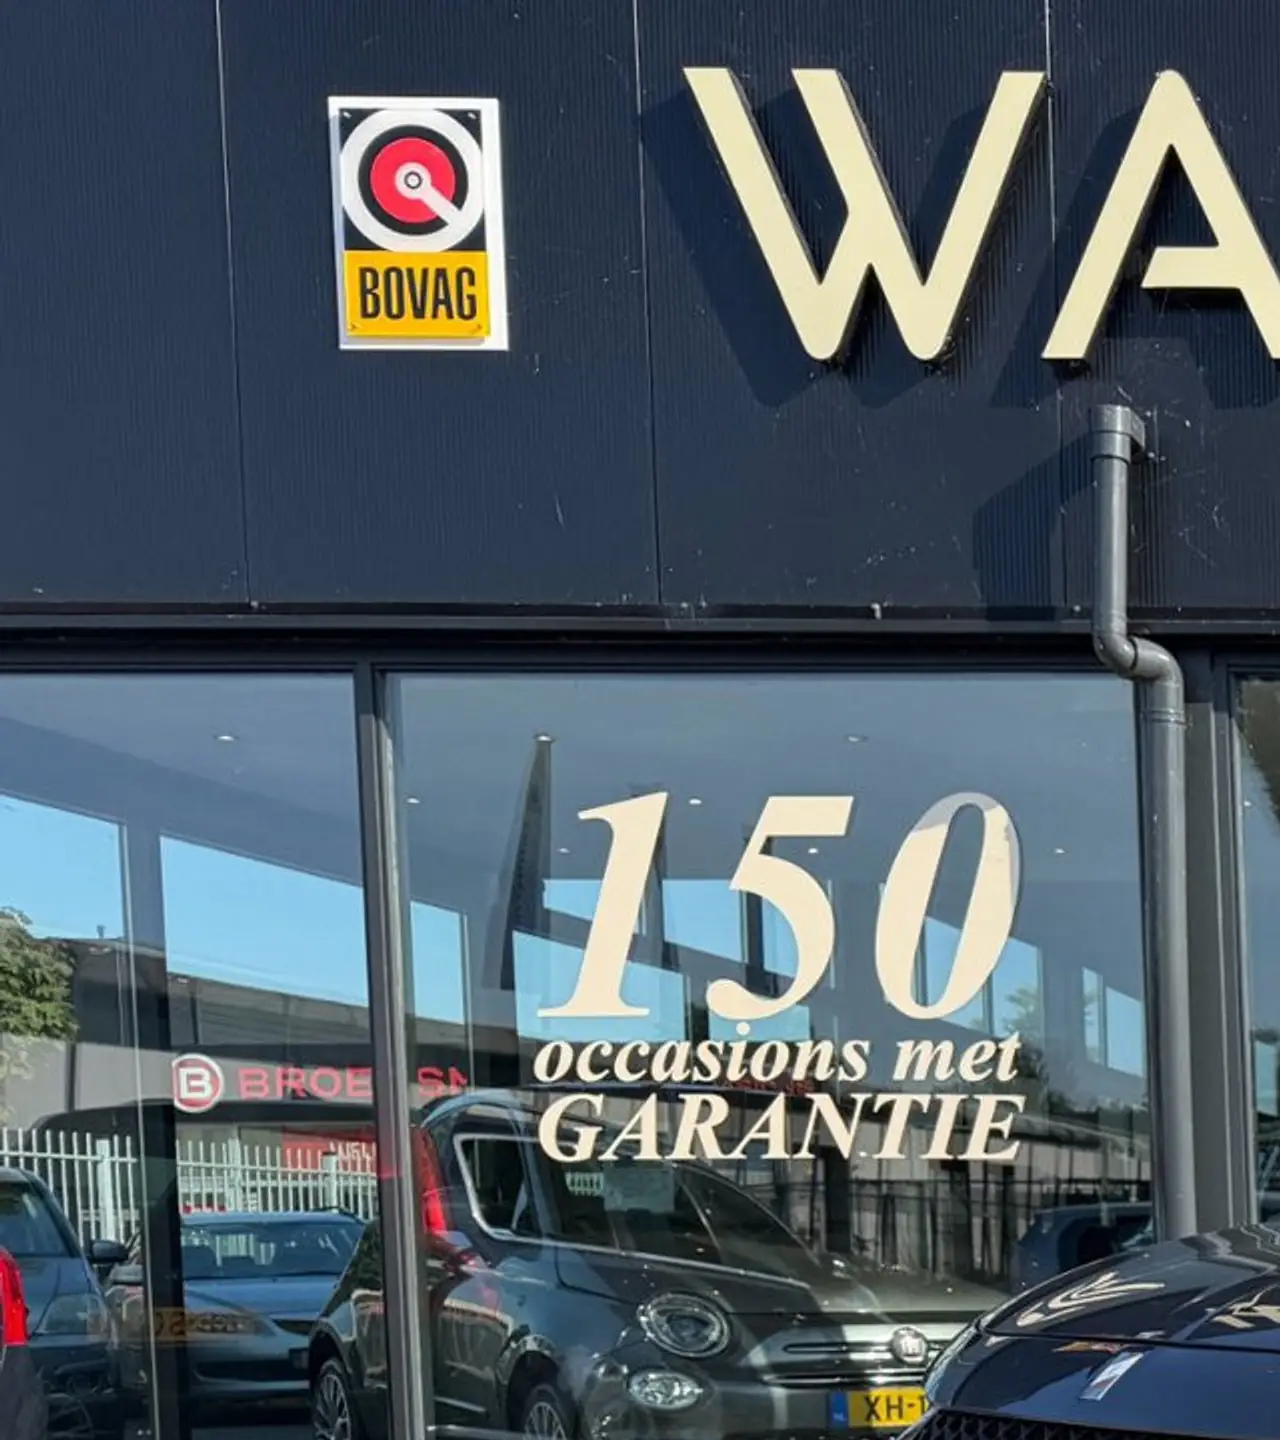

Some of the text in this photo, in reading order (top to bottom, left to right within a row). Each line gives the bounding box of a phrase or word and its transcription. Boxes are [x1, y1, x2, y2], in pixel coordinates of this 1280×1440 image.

[358, 267, 477, 320] BOVAG
[536, 791, 1022, 1021] 150
[533, 1022, 1022, 1082] occasions met
[537, 1092, 1026, 1164] GARANTIE
